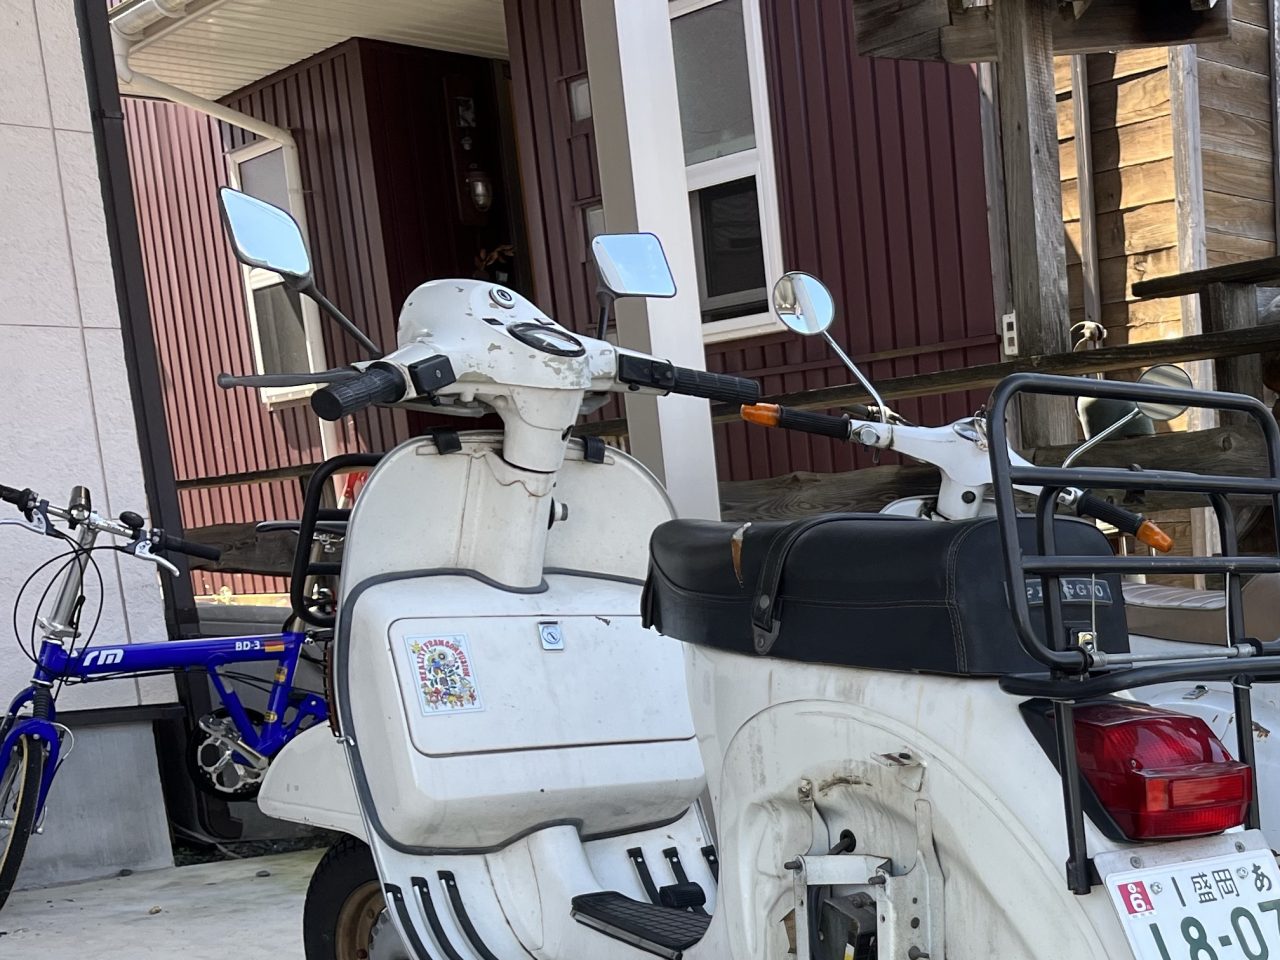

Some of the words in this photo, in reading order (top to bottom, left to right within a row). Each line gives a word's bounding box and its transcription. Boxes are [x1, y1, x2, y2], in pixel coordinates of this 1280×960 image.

[235, 640, 260, 651] BD-3
[1191, 868, 1240, 904] 盛岡
[1252, 863, 1272, 892] あ
